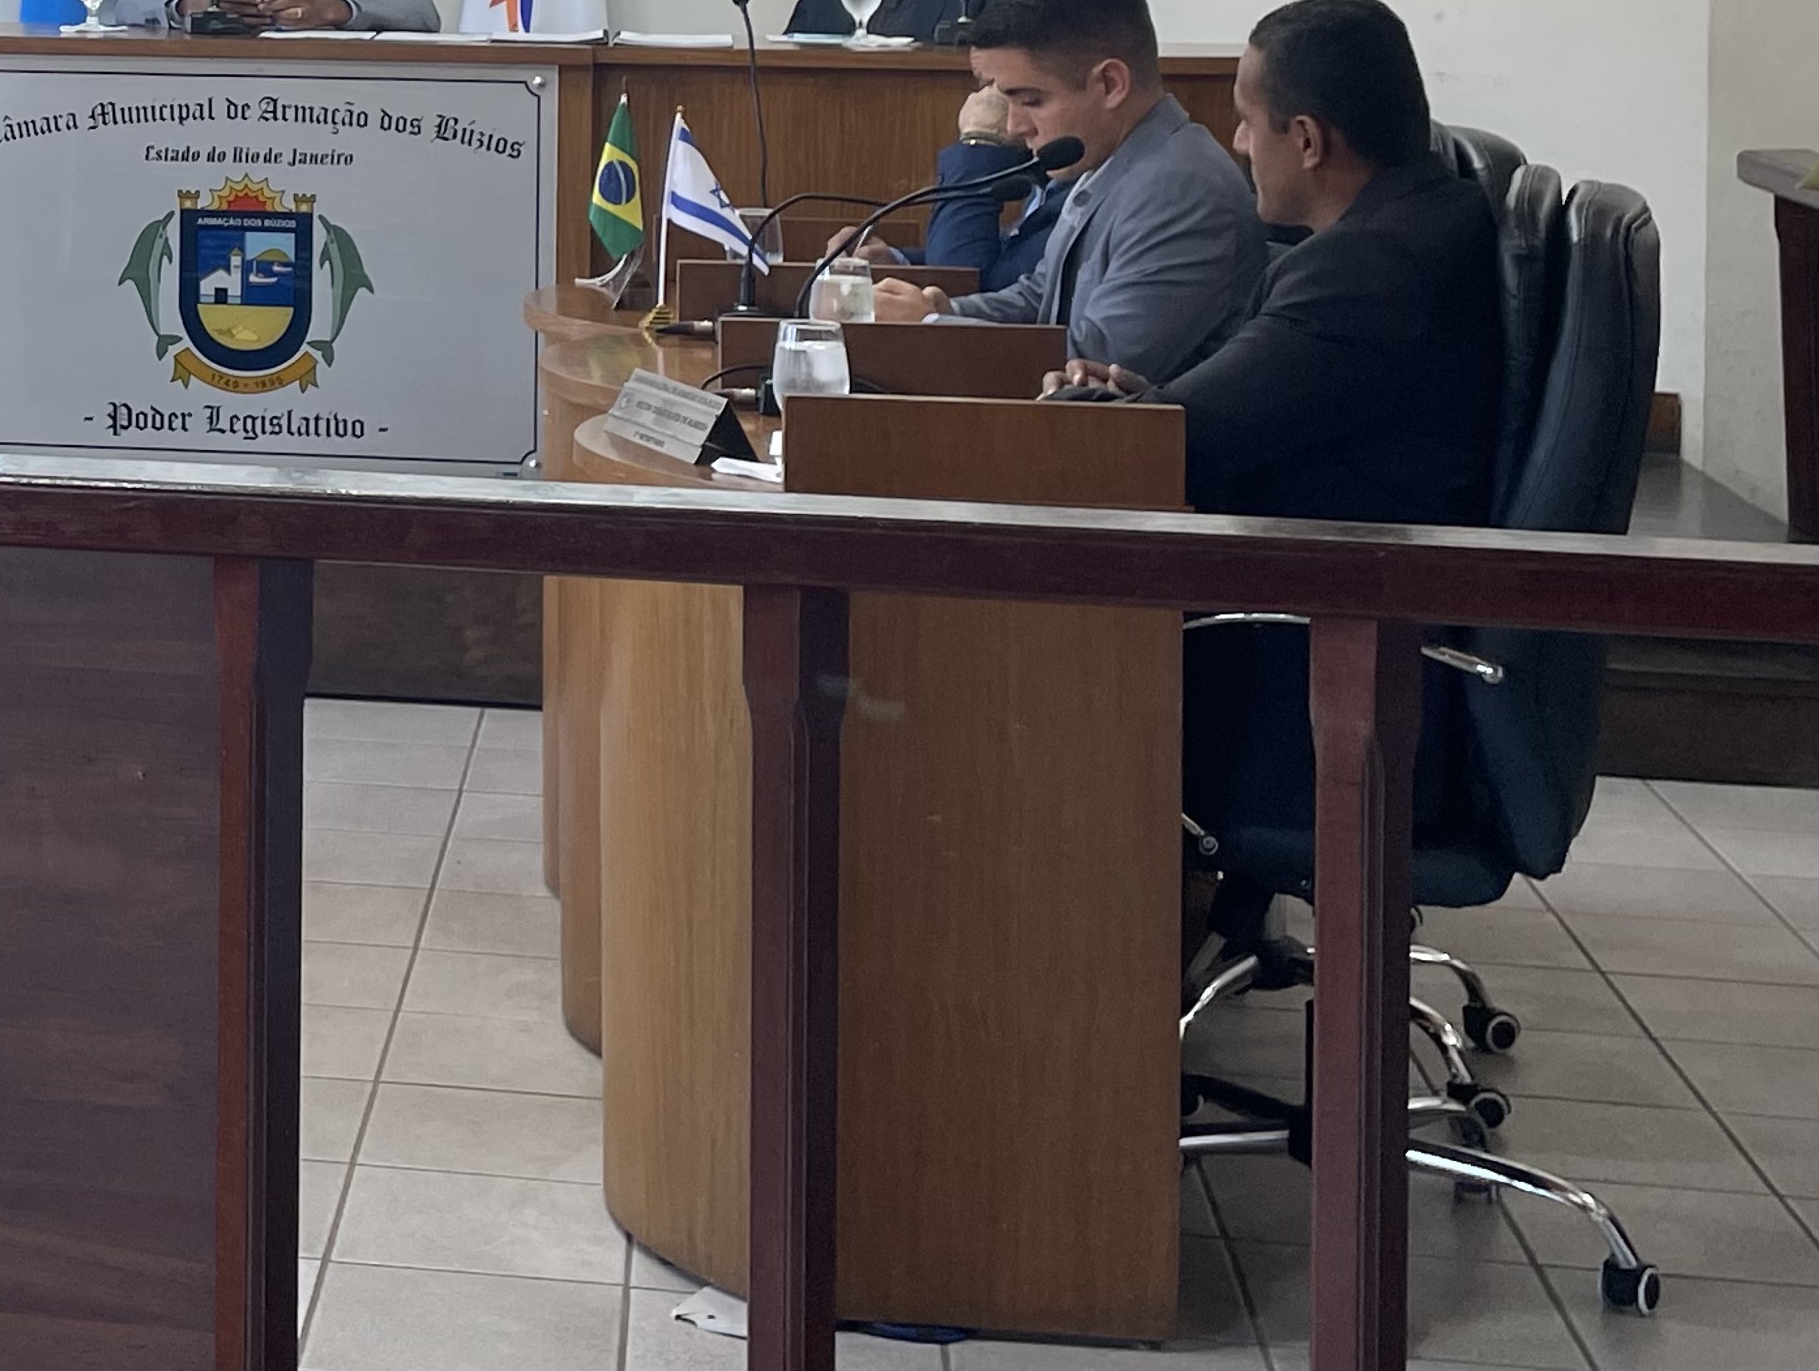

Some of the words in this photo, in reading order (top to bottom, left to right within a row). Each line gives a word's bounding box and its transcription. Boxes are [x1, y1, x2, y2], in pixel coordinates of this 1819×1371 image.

[88, 97, 216, 131] Municipal
[225, 97, 251, 121] de
[257, 96, 368, 135] Armação
[380, 108, 424, 136] dos
[431, 114, 525, 160] Búzios
[144, 144, 201, 163] Estado
[206, 146, 227, 164] do
[233, 146, 260, 164] Rio
[262, 147, 283, 165] de
[287, 148, 354, 167] Janeiro
[106, 401, 193, 436] Poder
[203, 404, 365, 441] Legislativo
